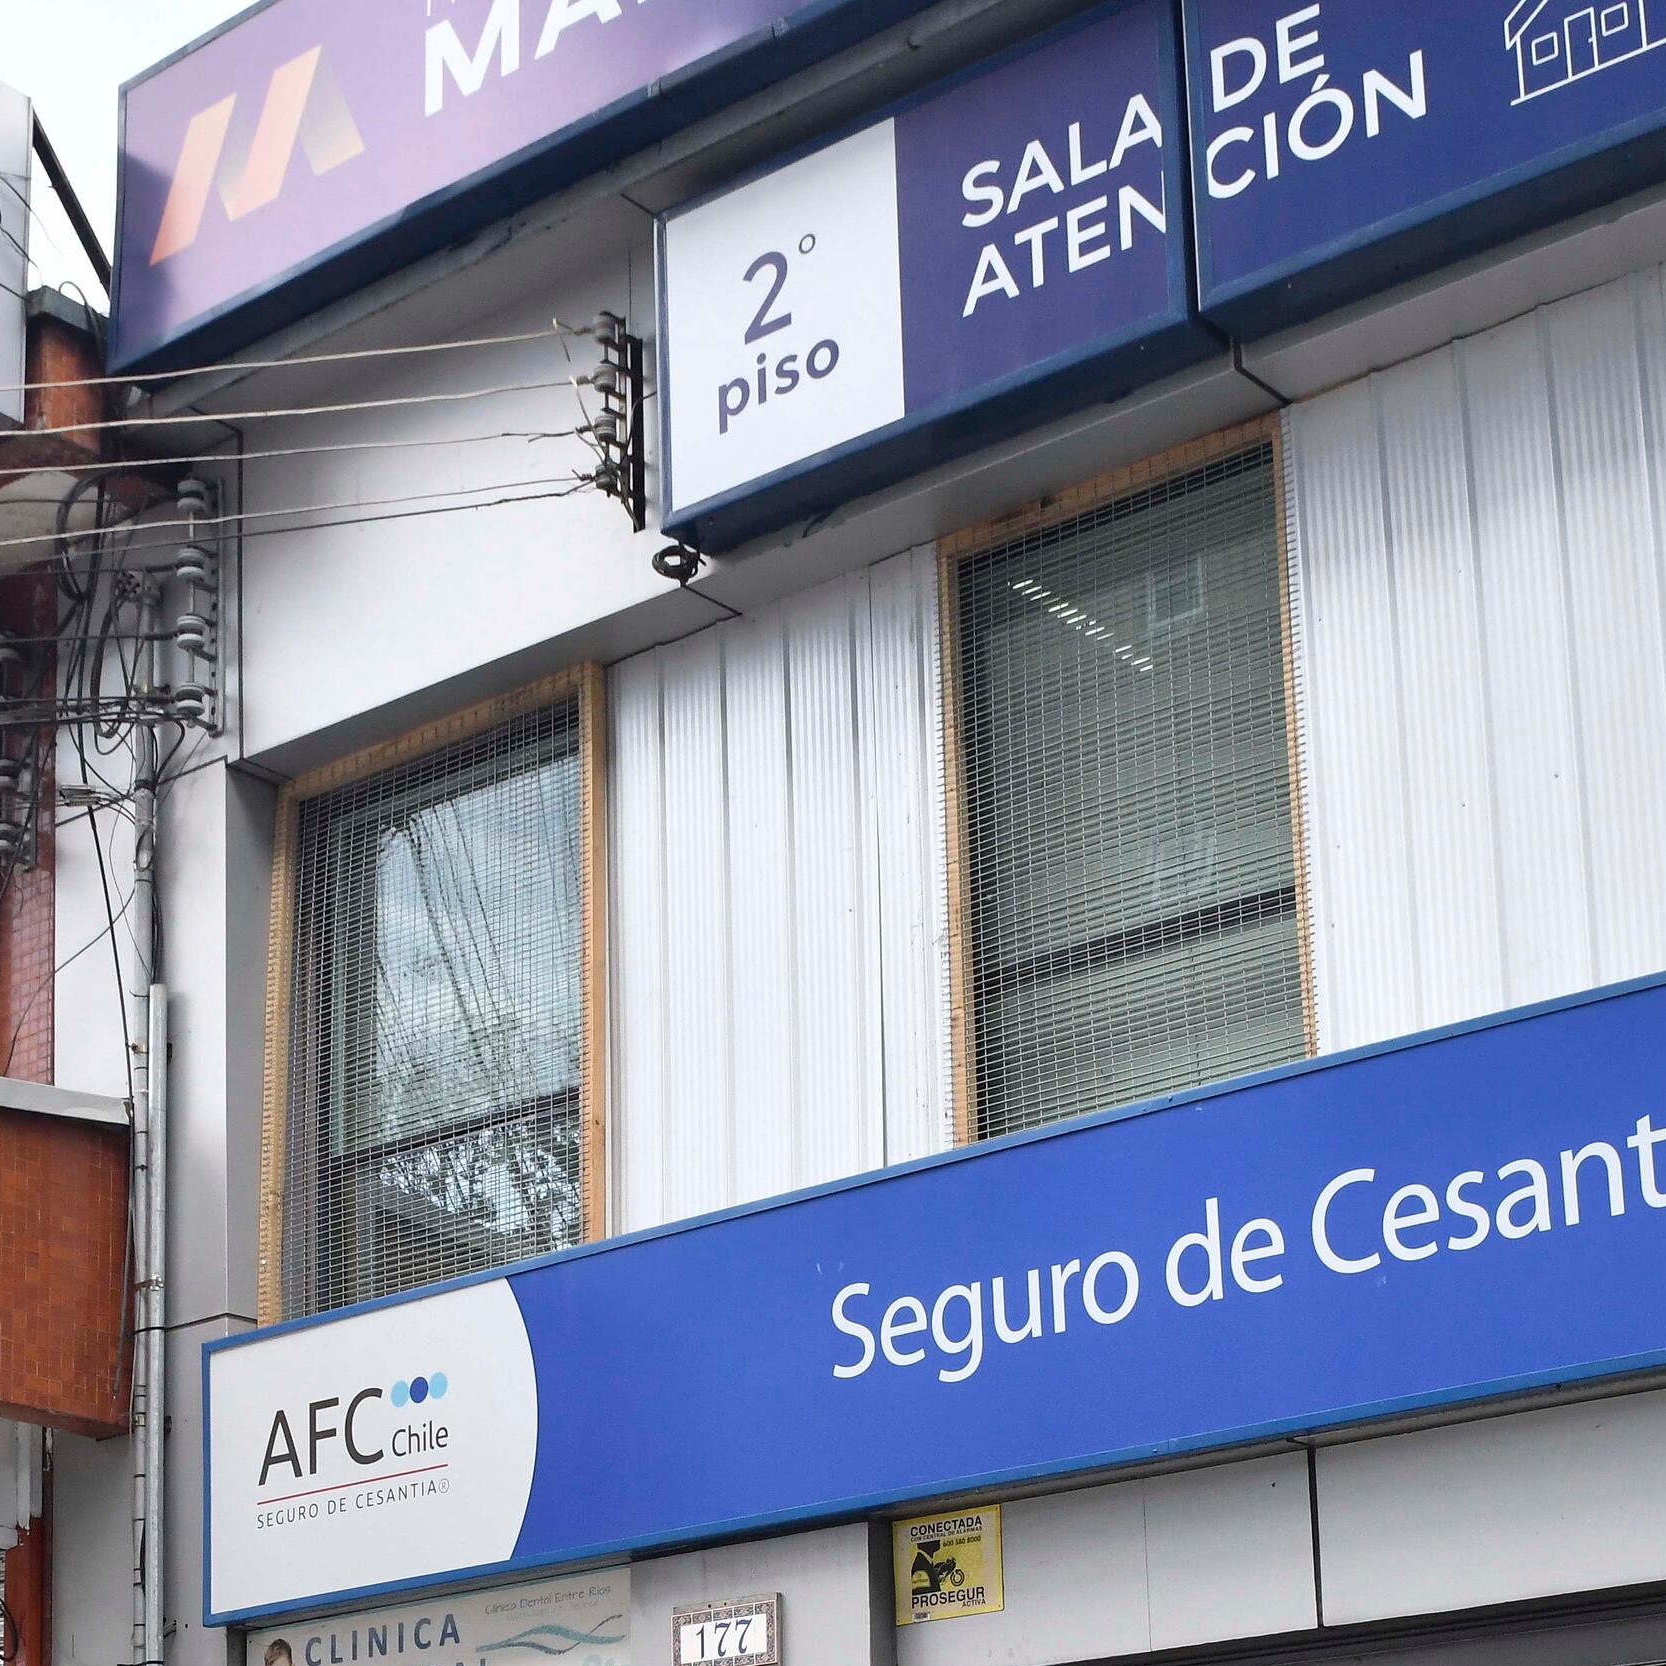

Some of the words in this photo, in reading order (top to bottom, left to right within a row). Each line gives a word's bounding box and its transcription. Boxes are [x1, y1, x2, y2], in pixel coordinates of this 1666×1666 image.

[425, 0, 646, 117] MA
[961, 93, 1163, 228] SALA
[1211, 3, 1324, 113] DE
[716, 337, 840, 433] piso
[830, 1249, 1140, 1384] Seguro
[1165, 1196, 1285, 1309] de
[258, 1387, 384, 1486] AFC
[392, 1420, 449, 1457] Chile
[257, 1503, 319, 1529] SEGURO
[327, 1497, 346, 1515] DE
[910, 1515, 982, 1537] CONECTADA
[912, 1586, 985, 1609] PROSEGUR
[962, 1599, 986, 1608] ACTIVA
[695, 1617, 754, 1660] 177
